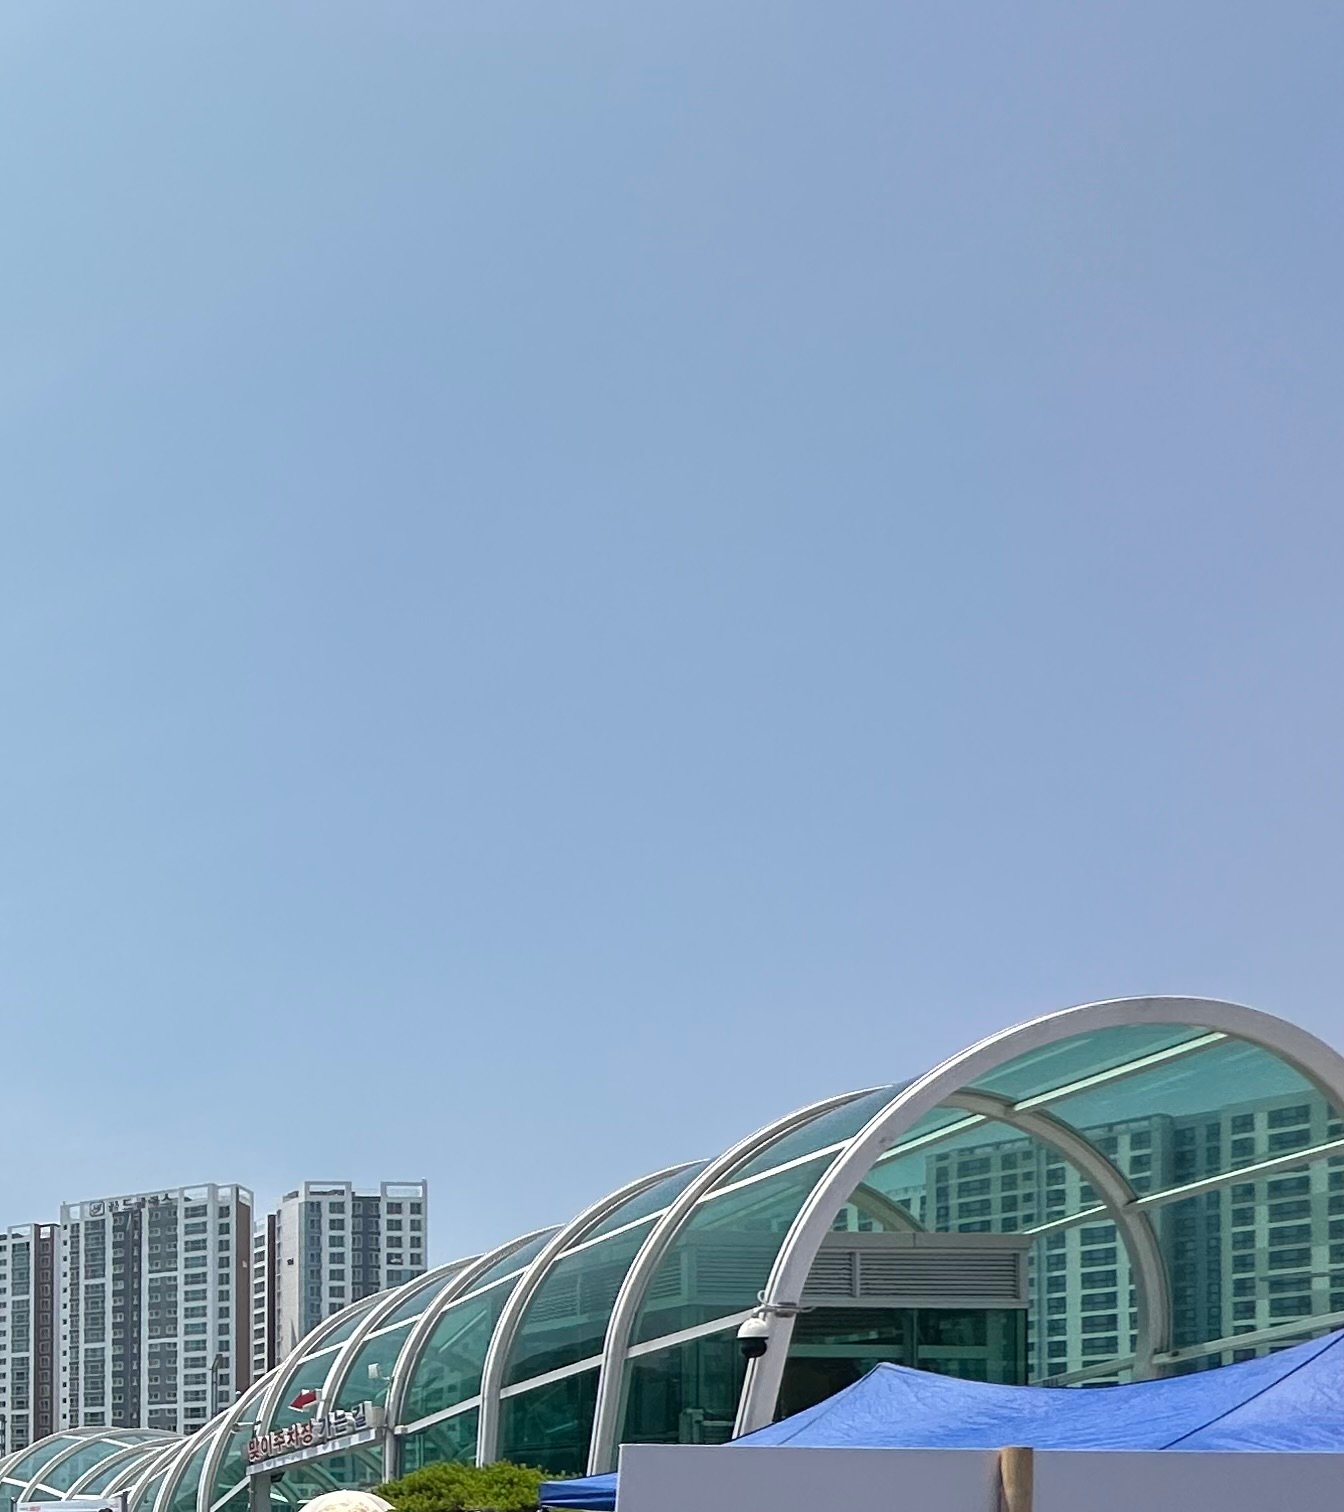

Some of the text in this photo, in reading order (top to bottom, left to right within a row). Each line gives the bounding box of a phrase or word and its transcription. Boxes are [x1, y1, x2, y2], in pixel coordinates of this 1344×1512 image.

[248, 1402, 367, 1462] 맞이주차장 가는 길
